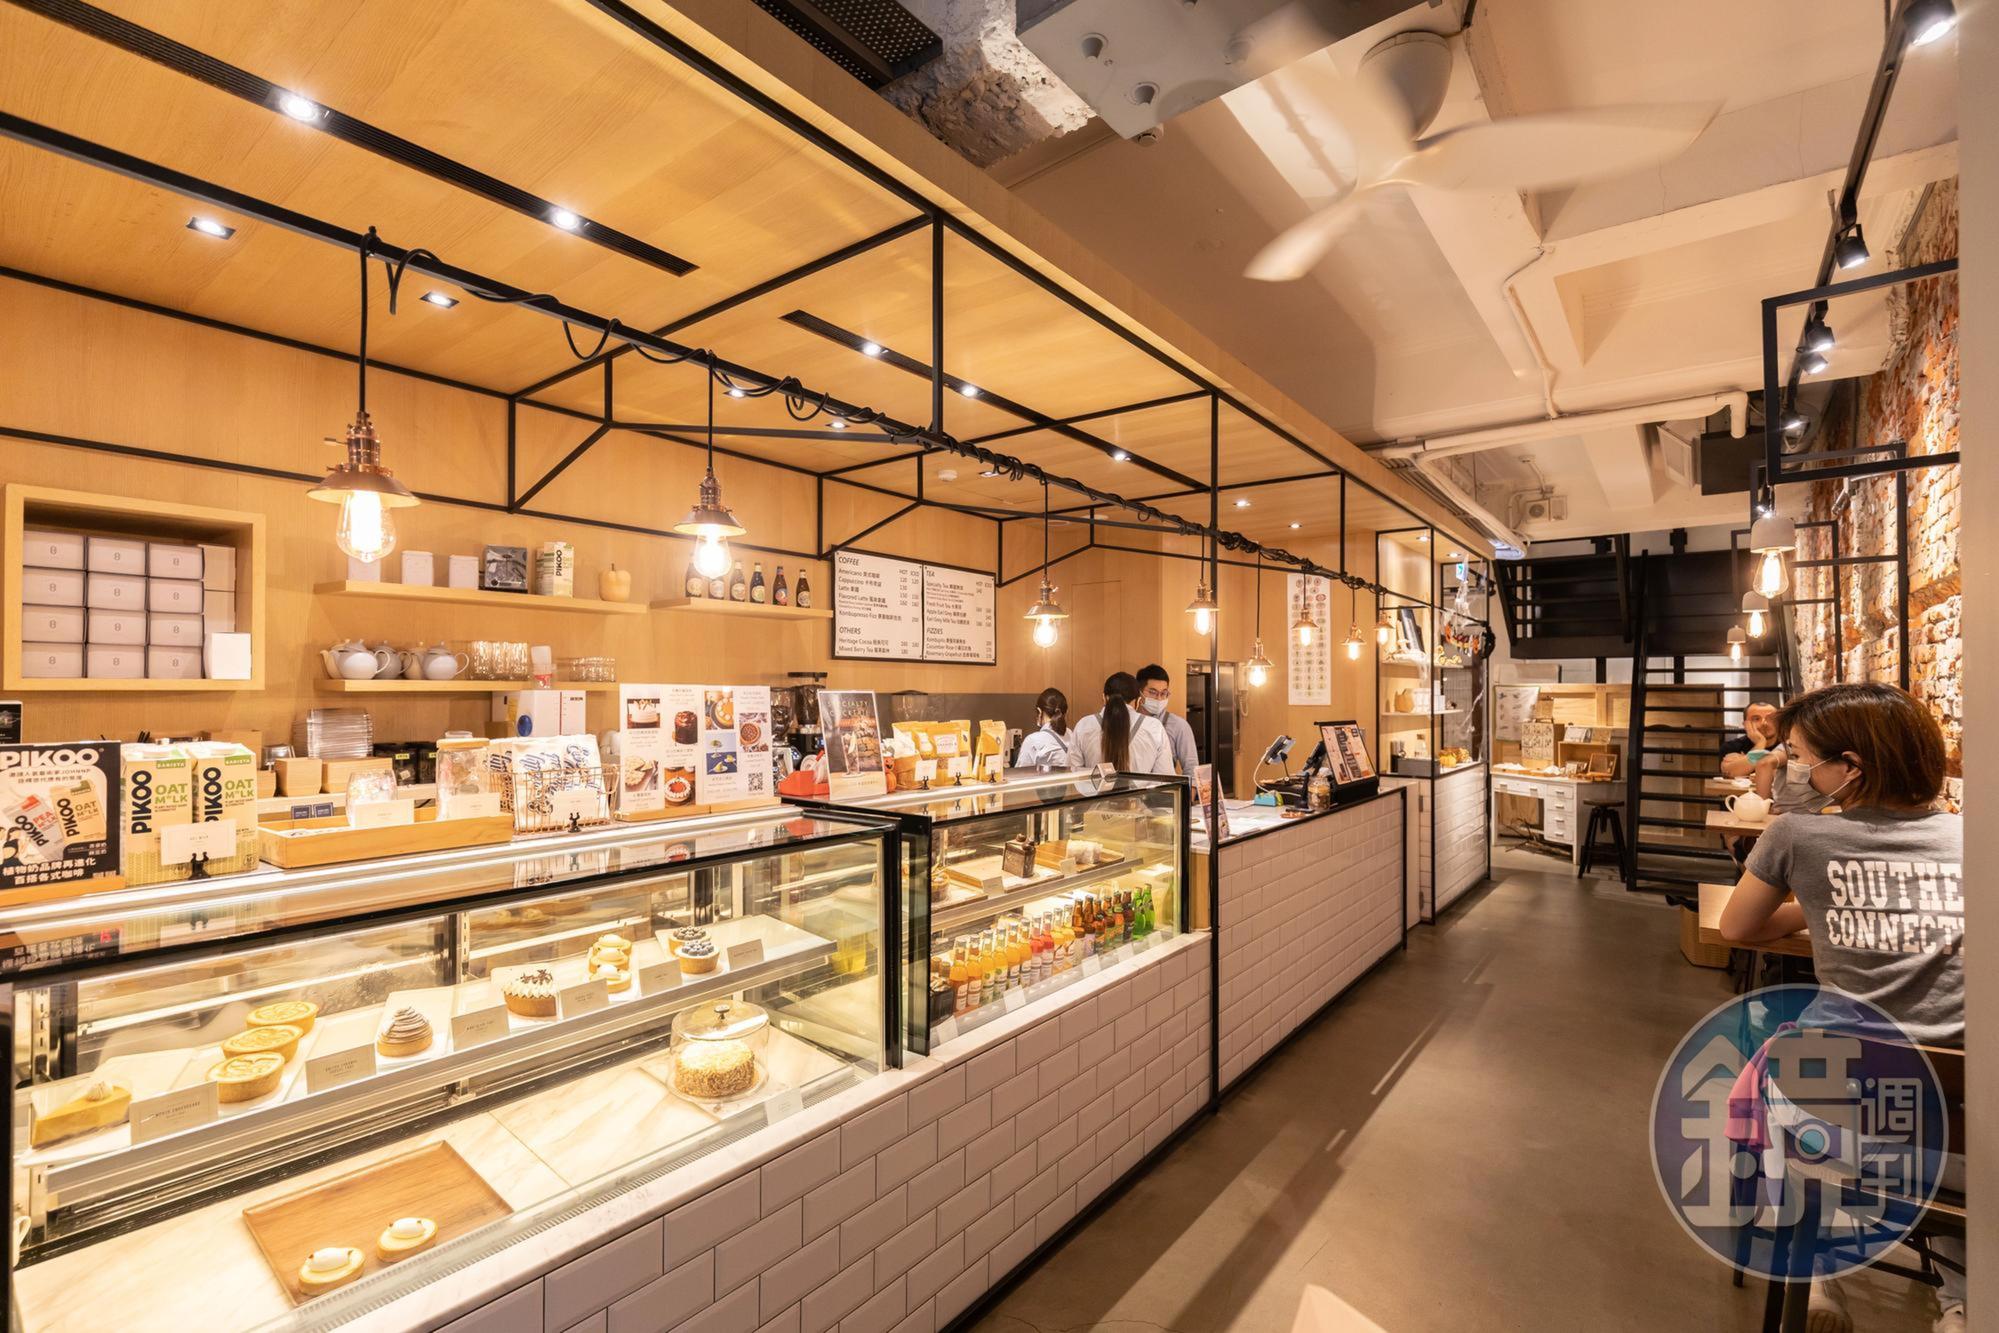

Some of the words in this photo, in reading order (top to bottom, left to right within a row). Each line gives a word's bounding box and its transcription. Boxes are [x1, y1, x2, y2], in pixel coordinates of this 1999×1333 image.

[838, 556, 860, 566] COFFEE
[838, 568, 862, 577] Americano
[838, 576, 864, 586] Cappuccino
[838, 626, 861, 635] OTHERS
[0, 748, 99, 771] PIKOO
[155, 783, 188, 795] OAT
[225, 778, 254, 791] OAT
[75, 801, 97, 811] OAT
[131, 770, 152, 834] PIKOO
[33, 811, 53, 823] PEA
[57, 798, 80, 838] PIKOO
[15, 815, 50, 847] PIKOO
